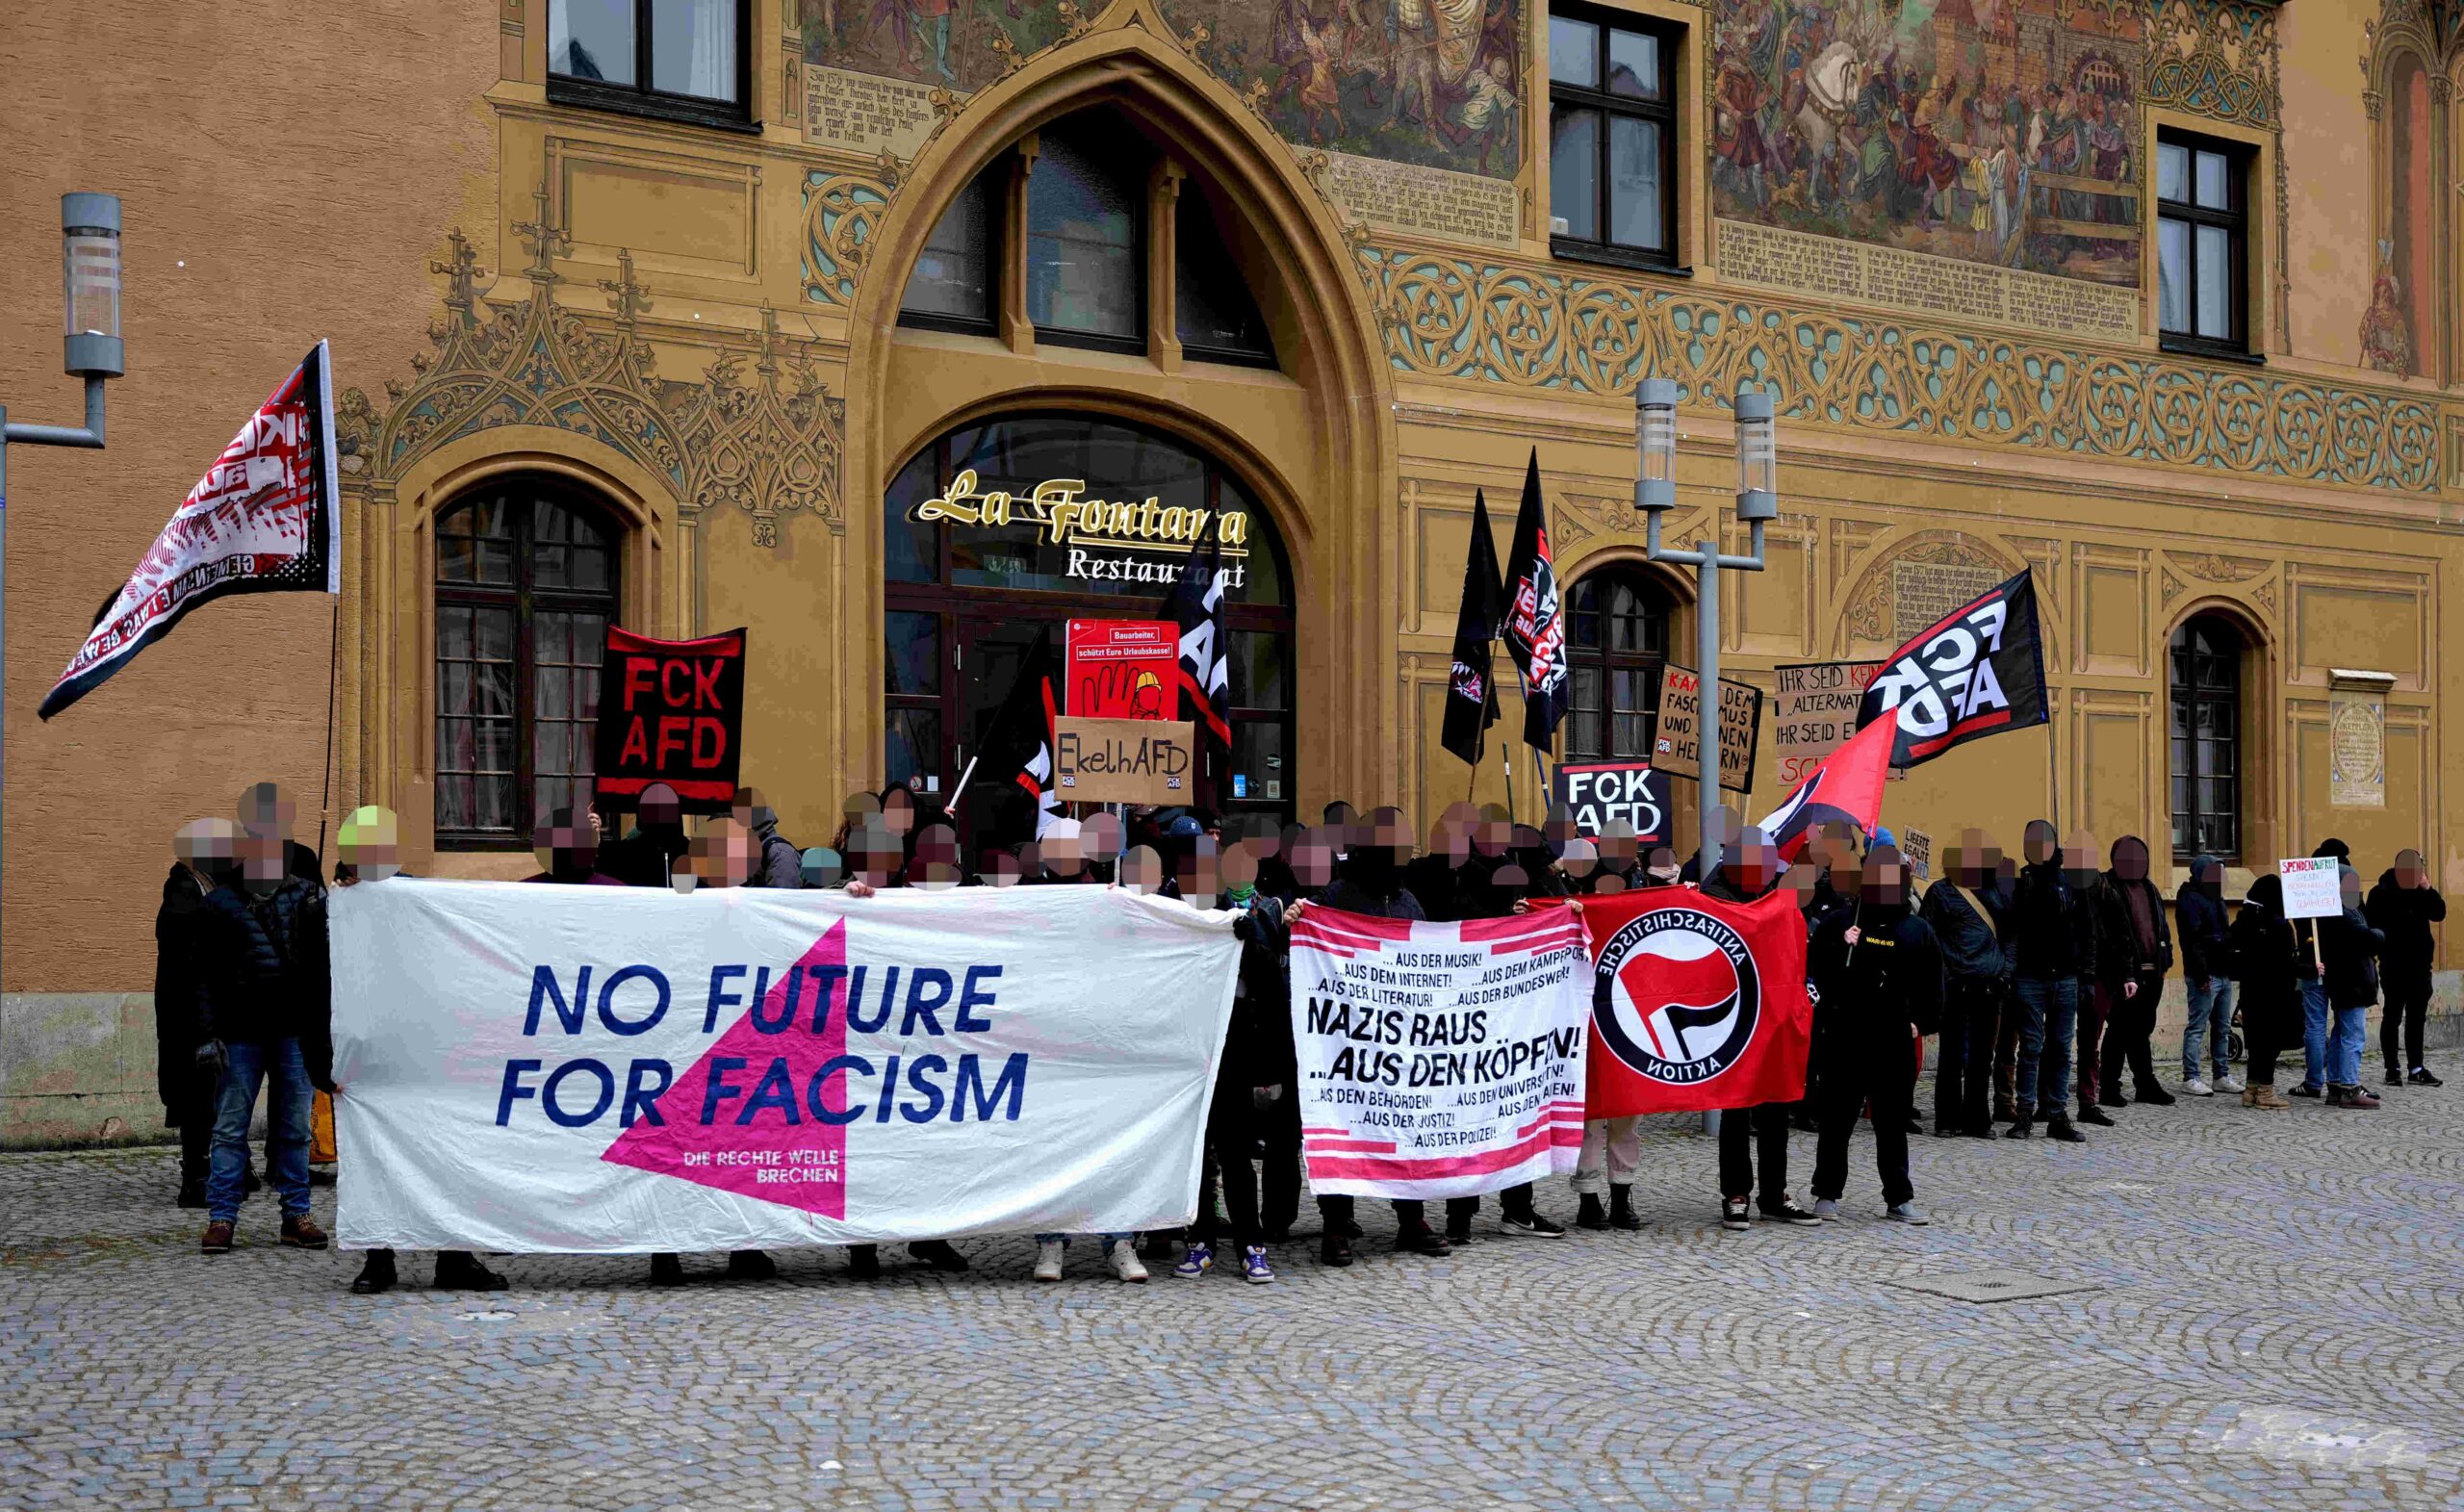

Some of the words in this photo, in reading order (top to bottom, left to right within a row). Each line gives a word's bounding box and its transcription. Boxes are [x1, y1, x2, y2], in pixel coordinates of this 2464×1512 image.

[918, 469, 1012, 525] La
[1033, 479, 1247, 544] Fontana
[1065, 549, 1245, 589] Restauant
[1115, 631, 1155, 640] Bauarbeiter,
[1078, 649, 1105, 657] schützt
[1106, 647, 1122, 656] Eure
[1123, 646, 1170, 655] Urlaubskasse!
[624, 656, 725, 711] FCK
[1780, 671, 1806, 692] IHR
[1810, 666, 1843, 689] SEID
[1726, 687, 1756, 710] DEM
[1787, 693, 1862, 716] „ALTERNAT
[1664, 716, 1691, 734] UND
[1777, 726, 1797, 745] IHR
[1801, 723, 1835, 742] SEID
[620, 714, 727, 770] AFD
[1058, 733, 1188, 777] EkelhAFD
[1569, 770, 1656, 804] FCK
[1396, 953, 1418, 967] AUS
[1421, 954, 1442, 968] DER
[1445, 953, 1482, 968] MUSIK!
[1504, 961, 1527, 980] DEM
[1371, 967, 1396, 985] DEM
[1399, 972, 1452, 987] INTERNET!
[523, 964, 672, 1037] NO
[702, 964, 1003, 1037] FUTURE
[1349, 983, 1369, 999] DER
[1372, 988, 1433, 1007] LITERATUR!
[1482, 987, 1502, 1004] DER
[1307, 996, 1403, 1045] NAZIS
[1409, 1011, 1487, 1046] RAUS
[1408, 1052, 1468, 1088] DEN
[496, 1058, 674, 1129] FOR
[699, 1052, 1029, 1127] FACISM
[1337, 1089, 1365, 1105] DEN
[1369, 1090, 1432, 1109] BEHÖRDEN!
[1479, 1088, 1498, 1105] DEN
[1498, 1102, 1521, 1118] AUS
[1523, 1094, 1540, 1112] DEN
[1393, 1114, 1414, 1128] DER
[1418, 1113, 1455, 1128] JUSTIZ!
[1438, 1131, 1458, 1146] DER
[1460, 1128, 1497, 1145] POLIZEI!
[683, 1151, 711, 1166] DIE
[716, 1150, 782, 1166] RECHTE
[788, 1149, 839, 1166] WELLE
[757, 1166, 838, 1184] BRECHEN
